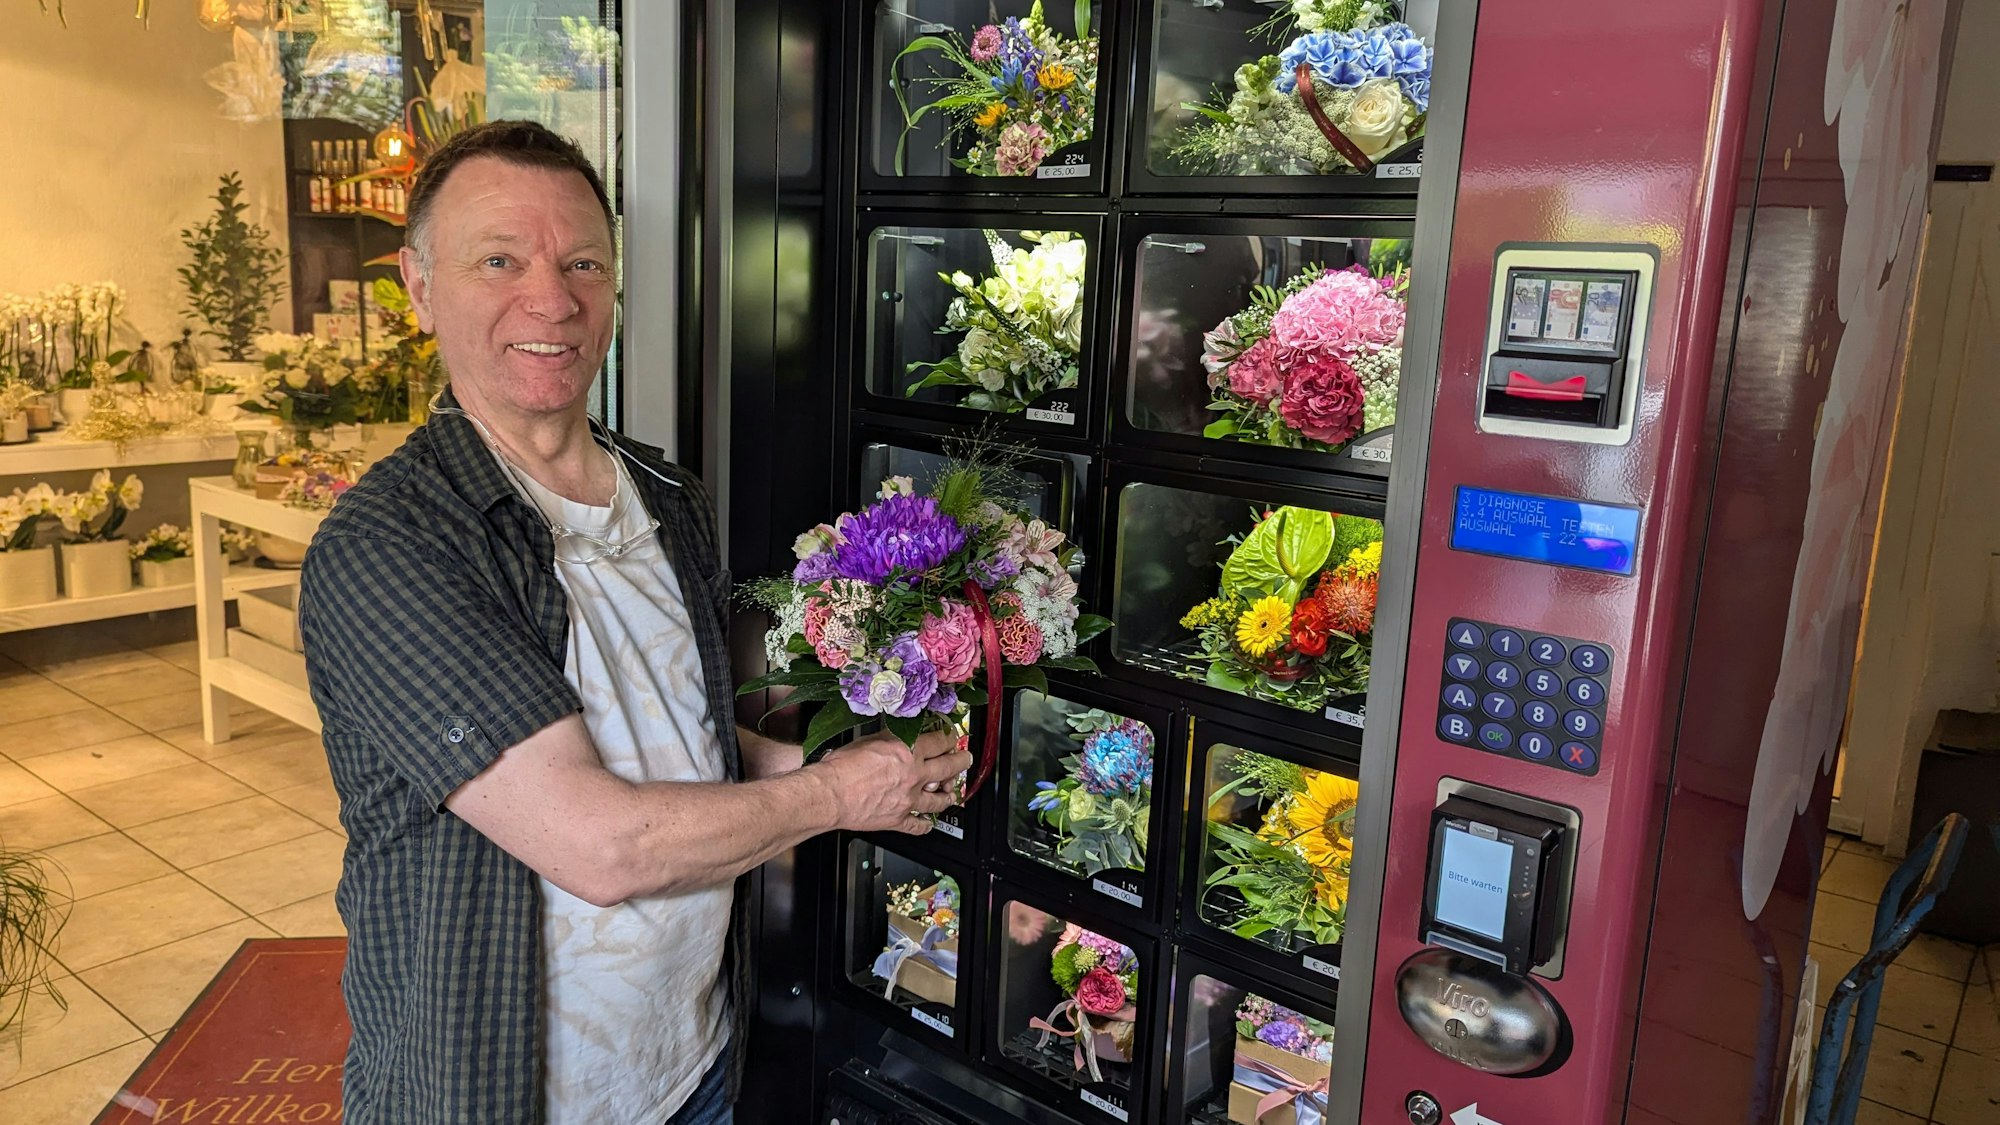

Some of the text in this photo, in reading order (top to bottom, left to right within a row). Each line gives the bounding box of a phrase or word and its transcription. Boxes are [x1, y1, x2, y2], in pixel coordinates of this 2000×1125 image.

[1065, 154, 1084, 164] 224
[1052, 167, 1075, 176] 25,00
[1387, 166, 1394, 175] €
[1050, 401, 1069, 412] 222
[1042, 411, 1063, 421] 30,00
[1362, 448, 1392, 461] € 30,
[1461, 491, 1546, 514] 3 DIAGNOSE
[1460, 504, 1615, 537] 3.4 AUSWAHL TESTEN
[1459, 518, 1516, 537] AUSWAHL
[1559, 532, 1576, 546] 22
[1501, 636, 1594, 668] 1 2 3
[1496, 667, 1590, 700] 4 5 6
[1336, 711, 1365, 726] € 35,
[1493, 697, 1505, 713] 7
[1532, 706, 1545, 723] 8
[1574, 715, 1587, 732] 9
[1487, 730, 1503, 742] OK
[1529, 737, 1541, 754] 0
[945, 814, 959, 826] 113
[1448, 870, 1503, 894] Bitte warten
[1100, 883, 1131, 900] € 20,00
[1312, 961, 1319, 969] €
[232, 1057, 344, 1085] Her
[152, 1094, 344, 1124] Willko
[1095, 1099, 1117, 1114] 20,00
